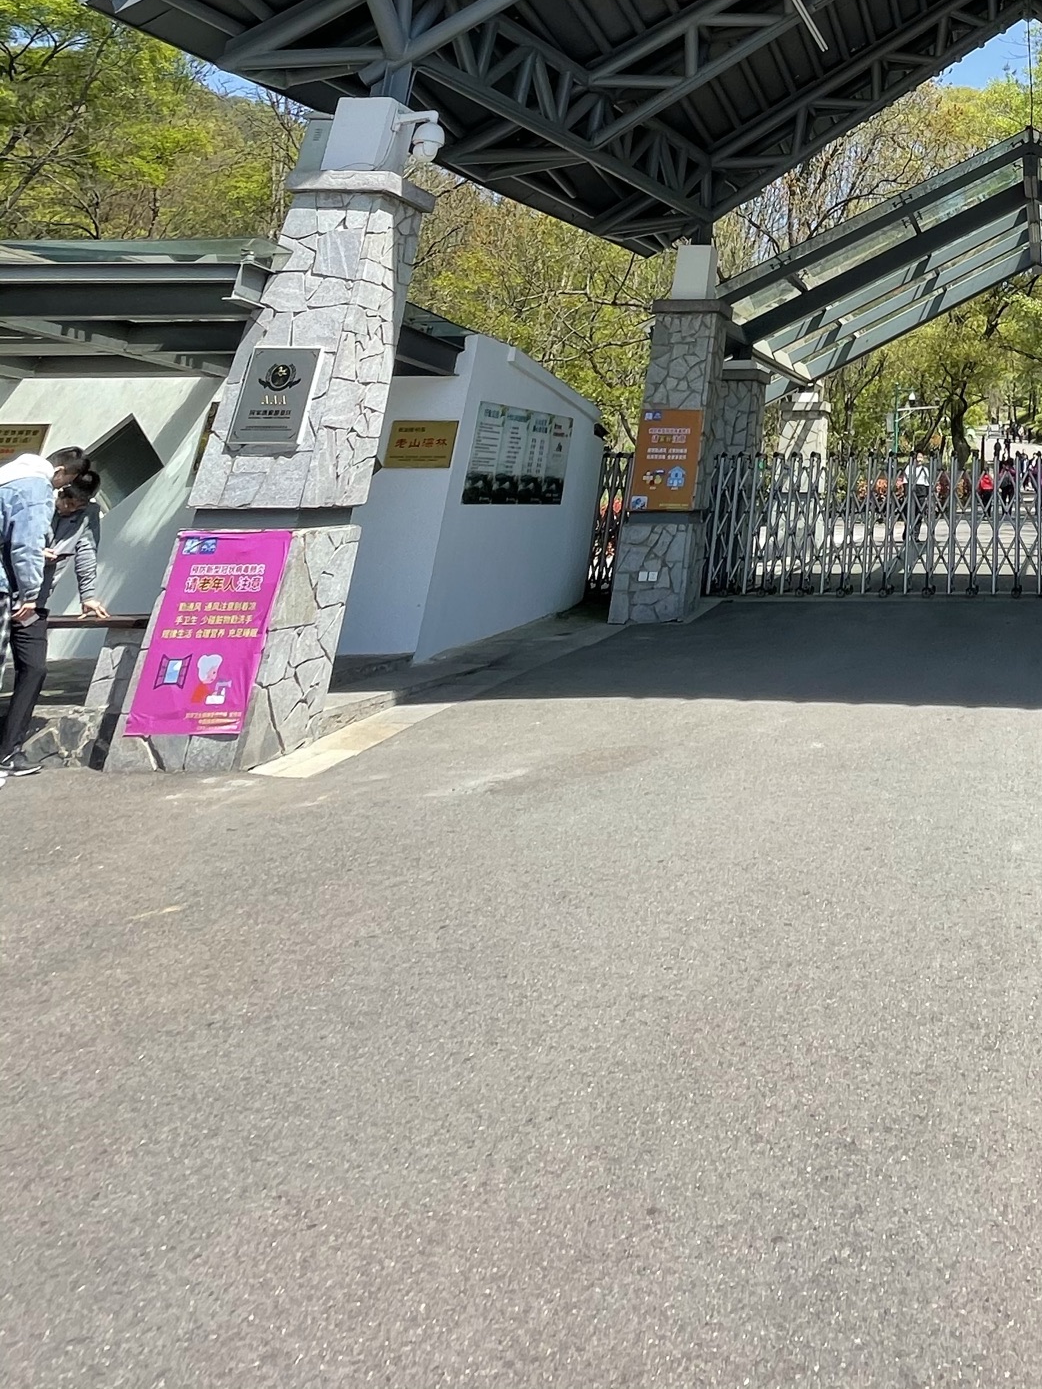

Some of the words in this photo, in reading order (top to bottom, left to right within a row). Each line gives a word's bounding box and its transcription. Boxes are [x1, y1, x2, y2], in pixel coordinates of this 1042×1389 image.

[184, 576, 264, 593] 请老年人注意
